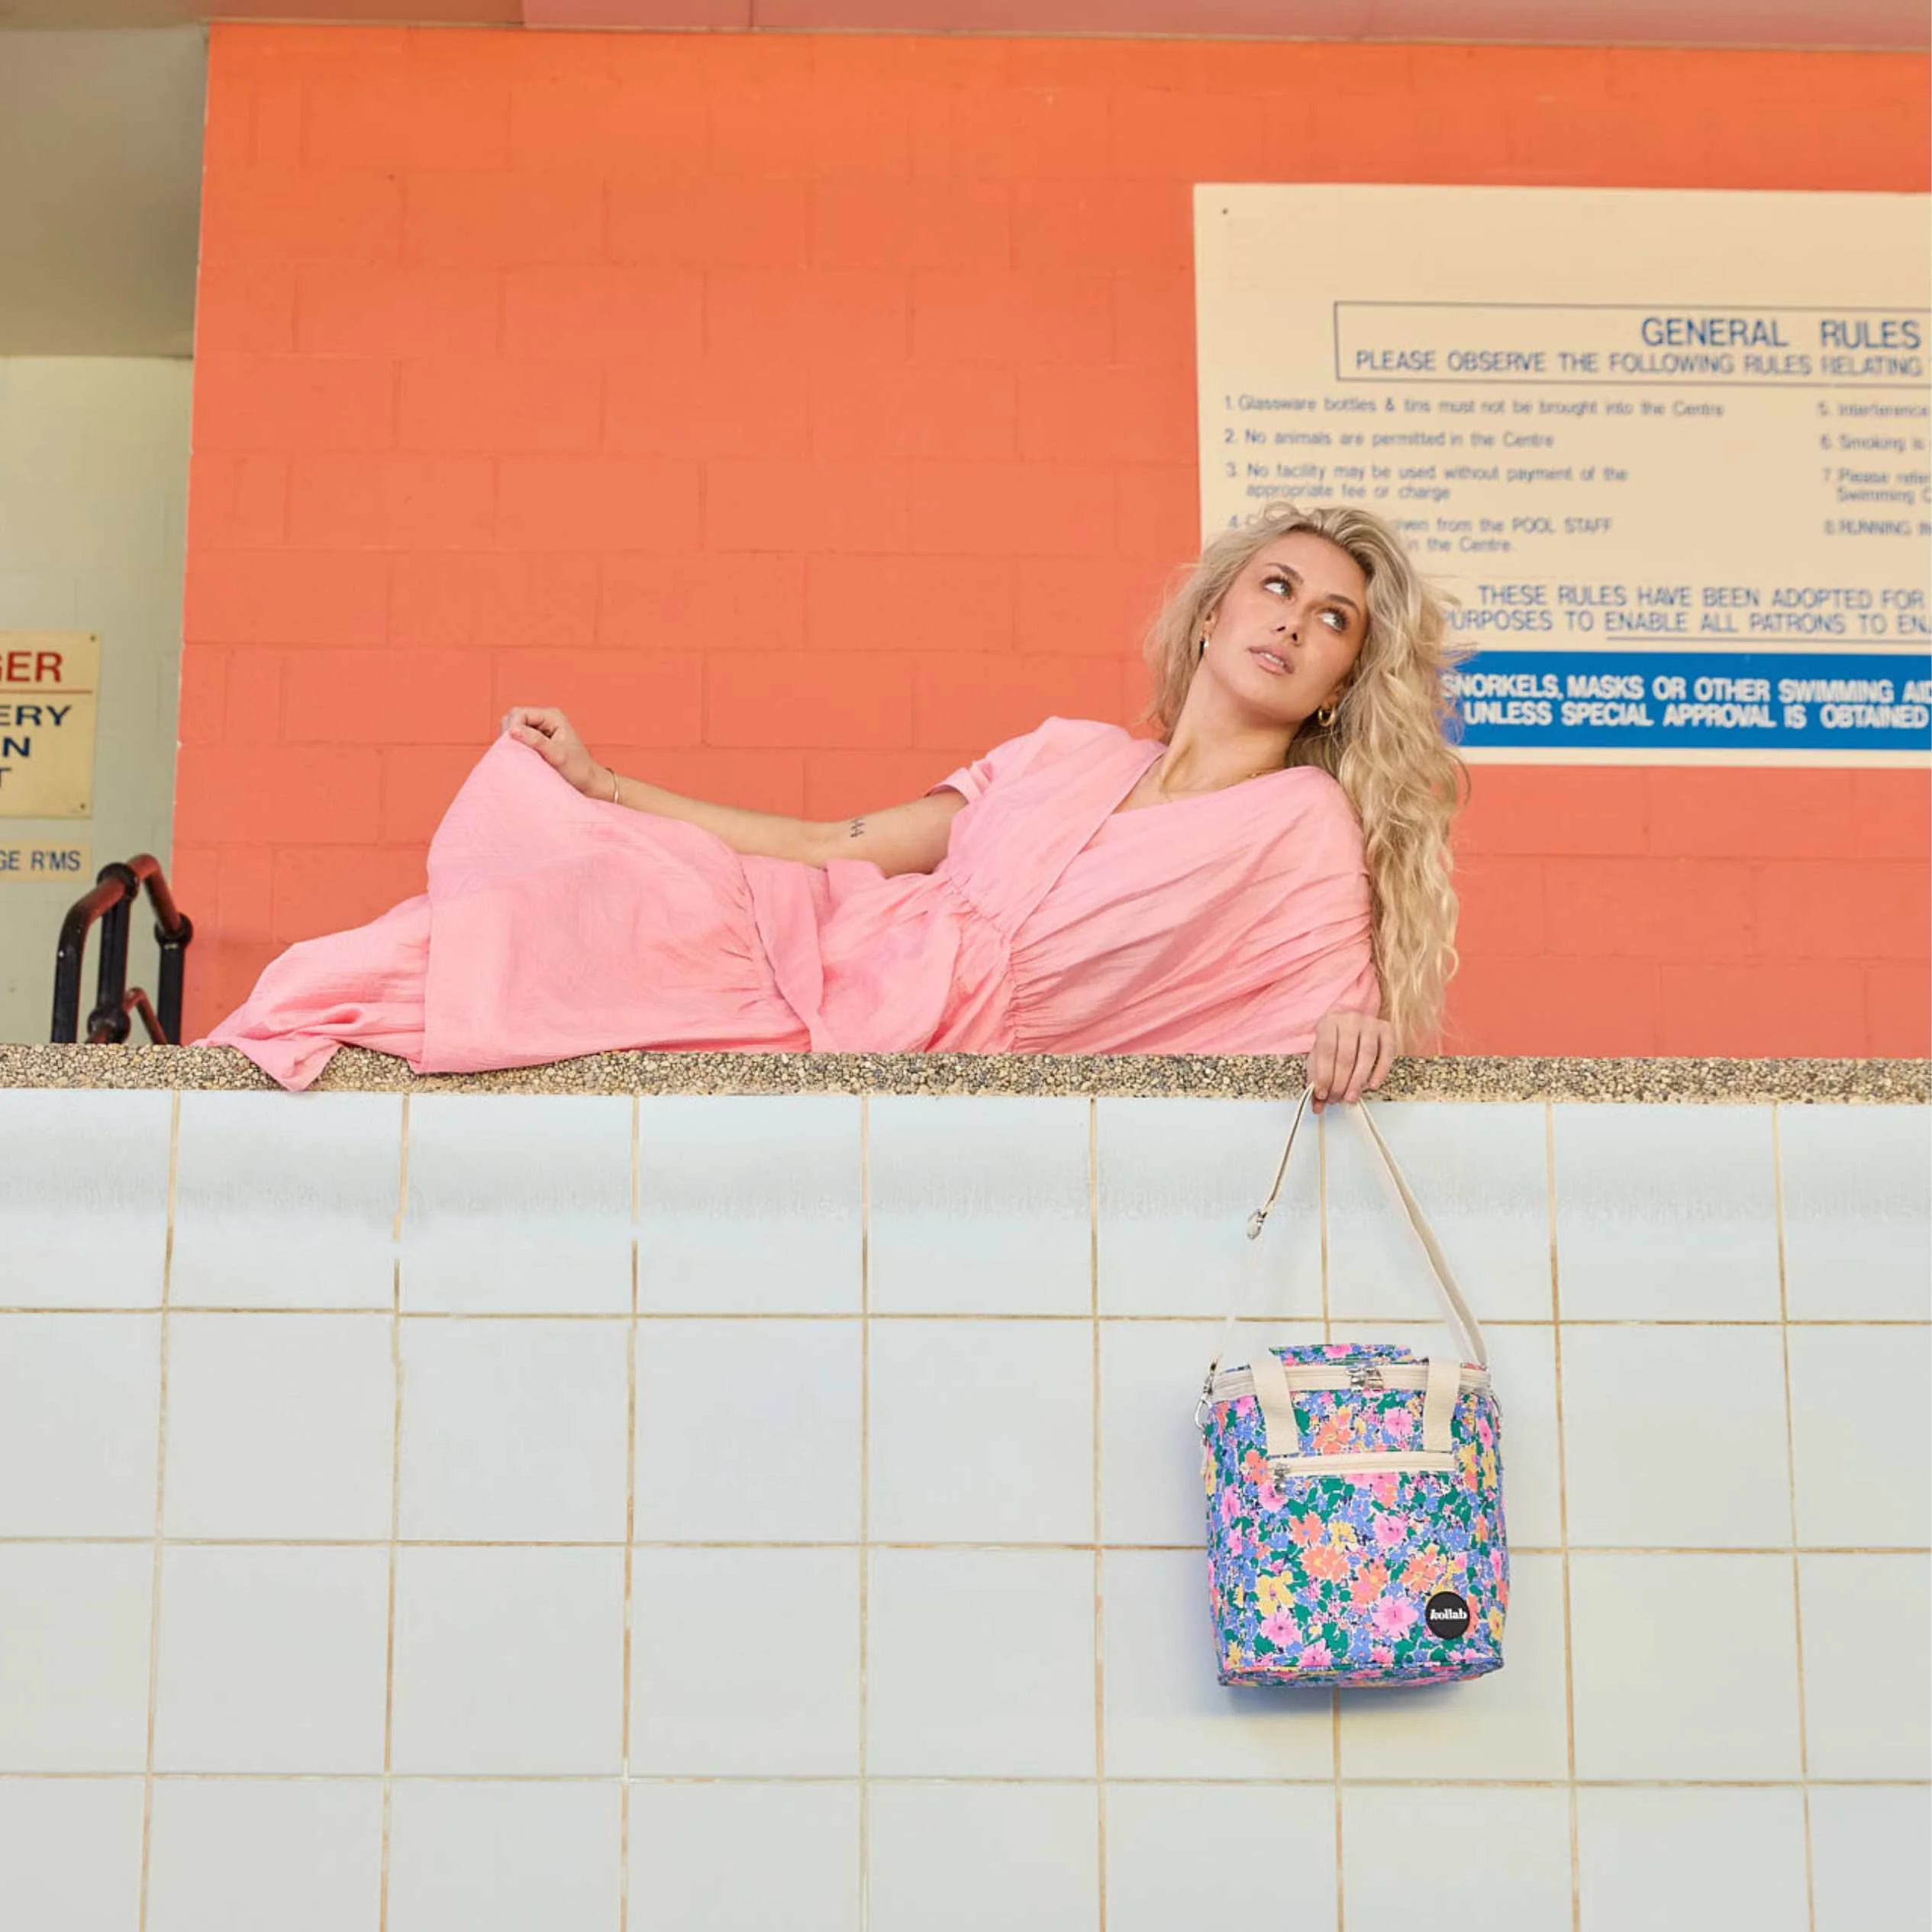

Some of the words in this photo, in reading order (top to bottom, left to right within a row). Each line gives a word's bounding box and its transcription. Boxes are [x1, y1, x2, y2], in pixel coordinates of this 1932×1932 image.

[1641, 318, 1789, 347] GENERAL
[1821, 320, 1921, 350] RULES
[1356, 350, 1436, 371] PLEASE
[1447, 350, 1545, 372] OBSERVE
[1558, 352, 1598, 373] THE
[1609, 353, 1734, 374] FOLLOWING
[1743, 354, 1812, 376] RULES
[1821, 356, 1922, 377] RELATING
[1238, 394, 1317, 411] Glassware
[1324, 398, 1376, 412] bottles
[1385, 398, 1395, 412] &
[1439, 401, 1475, 414] must
[1481, 400, 1505, 414] not
[1512, 401, 1533, 414] be
[1605, 402, 1634, 415] into
[1640, 402, 1666, 415] the
[1672, 401, 1724, 417] Centre
[1245, 429, 1266, 443] No
[1274, 432, 1332, 445] animals
[1340, 434, 1364, 446] are
[1372, 432, 1446, 448] permitted
[1450, 434, 1463, 446] in
[1470, 433, 1495, 447] the
[1503, 431, 1554, 447] Centre
[1247, 463, 1269, 477] No
[1334, 466, 1365, 481] may
[1372, 465, 1391, 479] be
[1399, 466, 1436, 479] used
[1444, 466, 1499, 480] without
[1507, 467, 1572, 483] payment
[1581, 466, 1595, 481] of
[1603, 467, 1627, 482] the
[1395, 519, 1429, 532] iven
[1437, 517, 1472, 532] from
[1479, 518, 1504, 533] the
[1512, 517, 1555, 534] POOL
[1564, 517, 1611, 534] STAFF
[1427, 538, 1451, 552] the
[1478, 585, 1547, 606] THESE
[1557, 585, 1627, 607] RULES
[1637, 587, 1691, 607] HAVE
[1703, 587, 1759, 608] BEEN
[1772, 588, 1872, 609] ADOPTED
[1881, 589, 1924, 611] FOR
[1447, 609, 1553, 631] URPOSES
[1564, 610, 1594, 632] TO
[1605, 611, 1687, 632] ENABLE
[1701, 613, 1738, 633] ALL
[1750, 612, 1846, 634] PATRONS
[1857, 613, 1888, 635] TO
[1898, 614, 1930, 634] EN
[0, 652, 62, 682] ER
[1566, 675, 1644, 700] MASKS
[1653, 676, 1686, 700] OR
[1694, 676, 1769, 702] OTHER
[1779, 679, 1895, 703] SWIMMING
[1463, 702, 1553, 725] UNLESS
[1561, 702, 1654, 726] SPECIAL
[1663, 702, 1777, 727] APPROVAL
[1783, 702, 1807, 729] IS
[1820, 702, 1930, 728] OBTAINED
[1430, 1608, 1467, 1620] kollab
